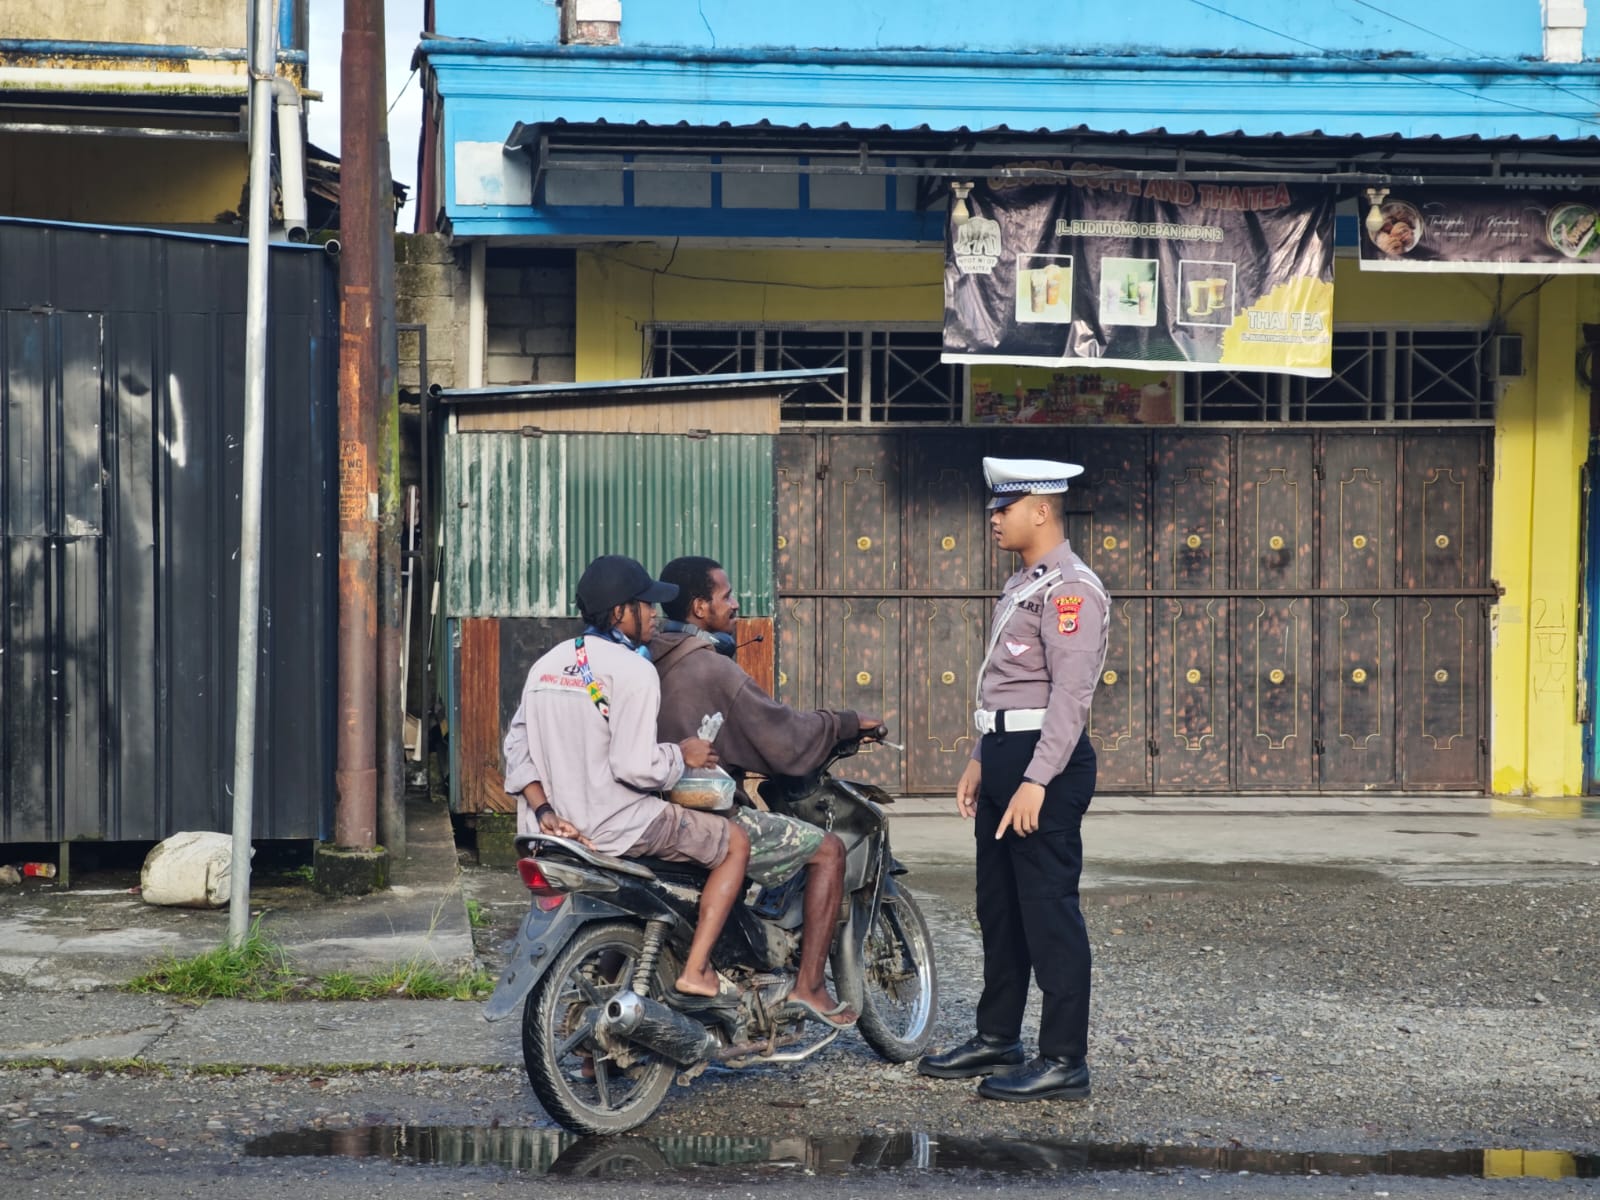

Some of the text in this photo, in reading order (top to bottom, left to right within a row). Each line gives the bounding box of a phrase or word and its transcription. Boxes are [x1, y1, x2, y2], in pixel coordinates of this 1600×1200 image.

[1143, 179, 1196, 206] AND
[1140, 223, 1178, 239] DEPAN
[1248, 311, 1323, 331] THAI TEA
